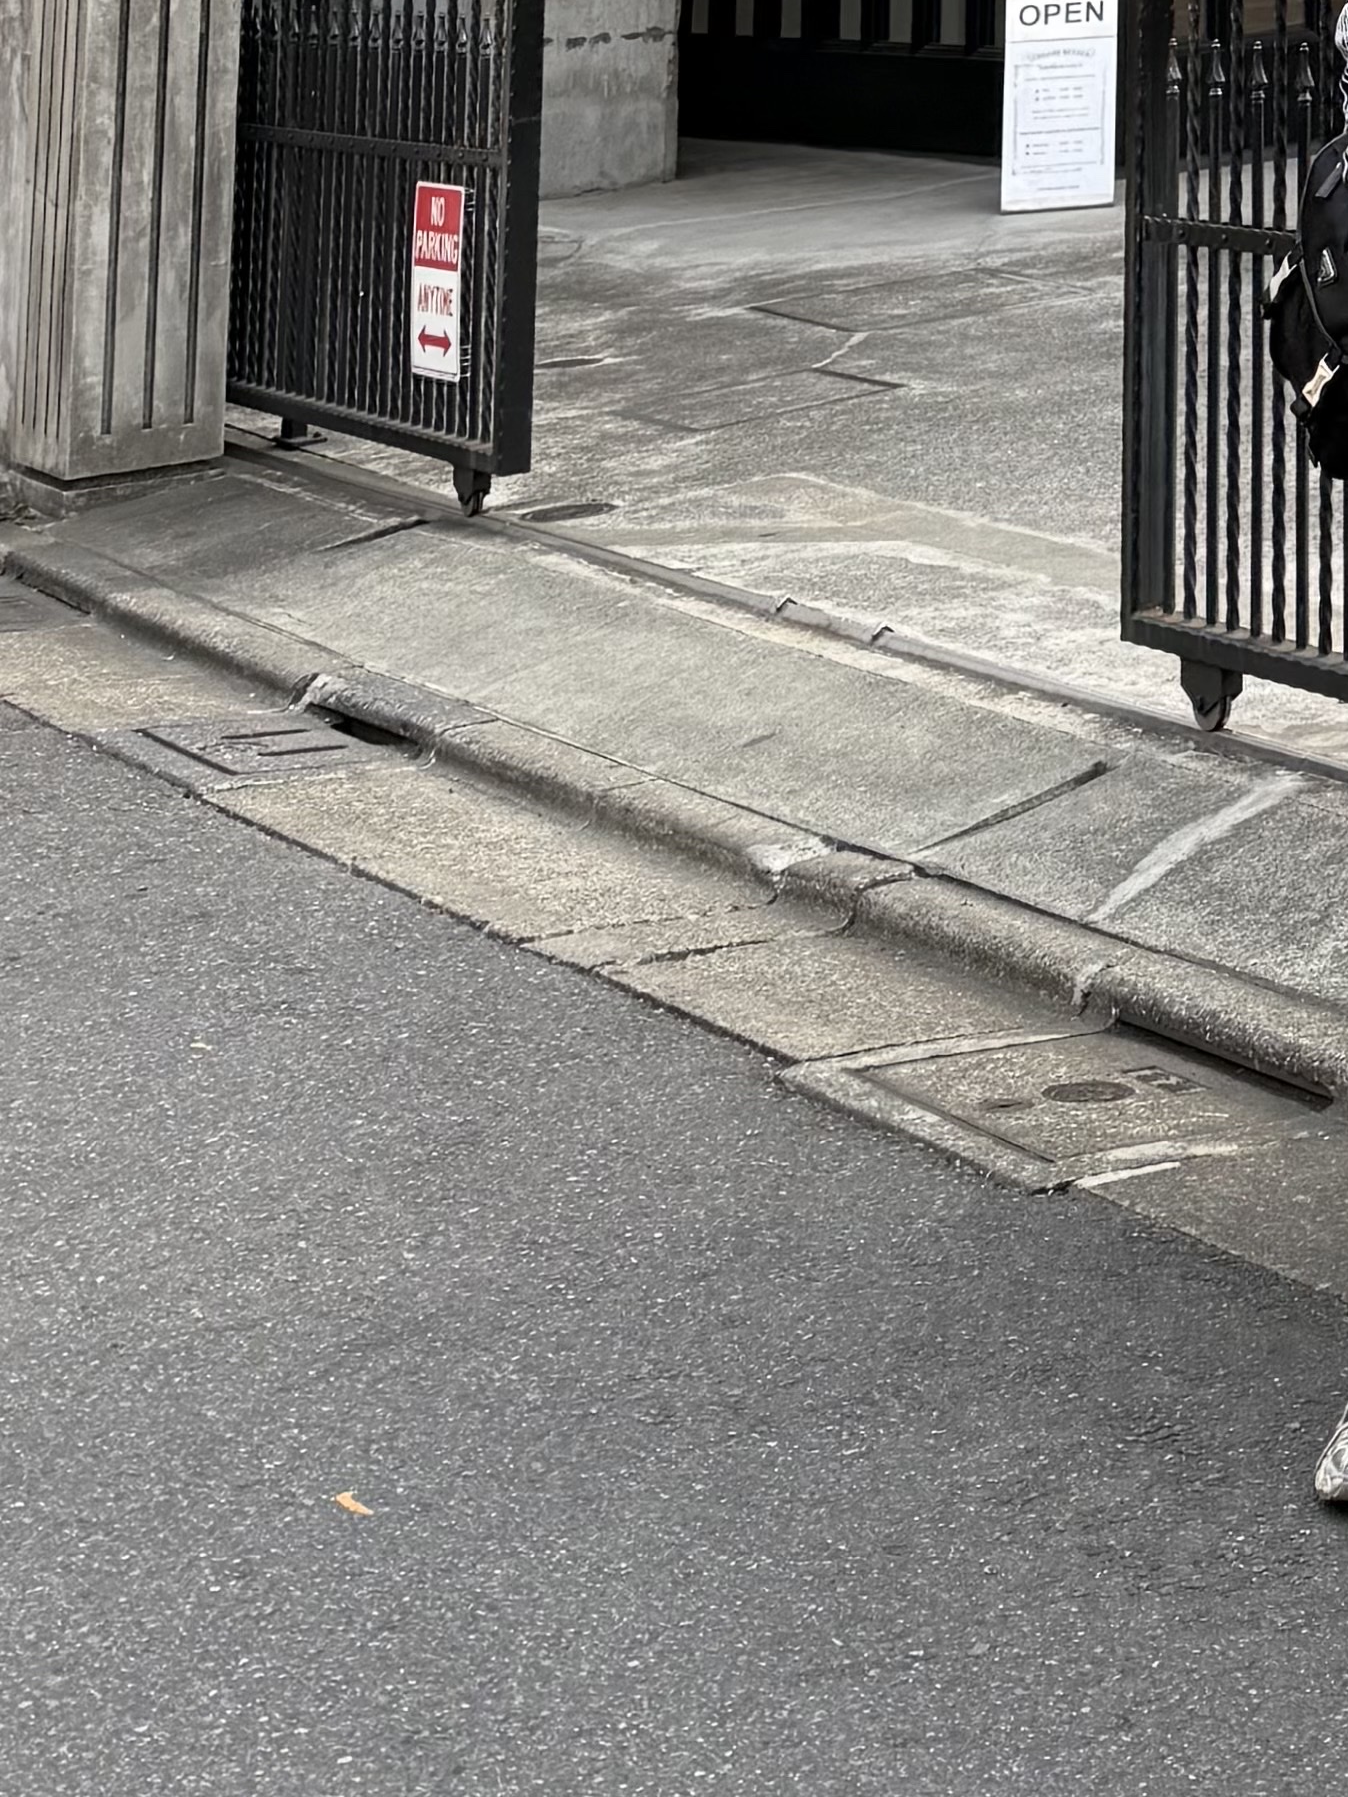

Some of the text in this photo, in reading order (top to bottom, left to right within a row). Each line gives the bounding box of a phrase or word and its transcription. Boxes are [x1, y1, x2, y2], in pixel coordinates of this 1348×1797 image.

[1019, 0, 1104, 26] OPEN
[431, 196, 445, 226] NO
[415, 230, 459, 264] PARKING
[417, 283, 453, 316] ANYTIME
